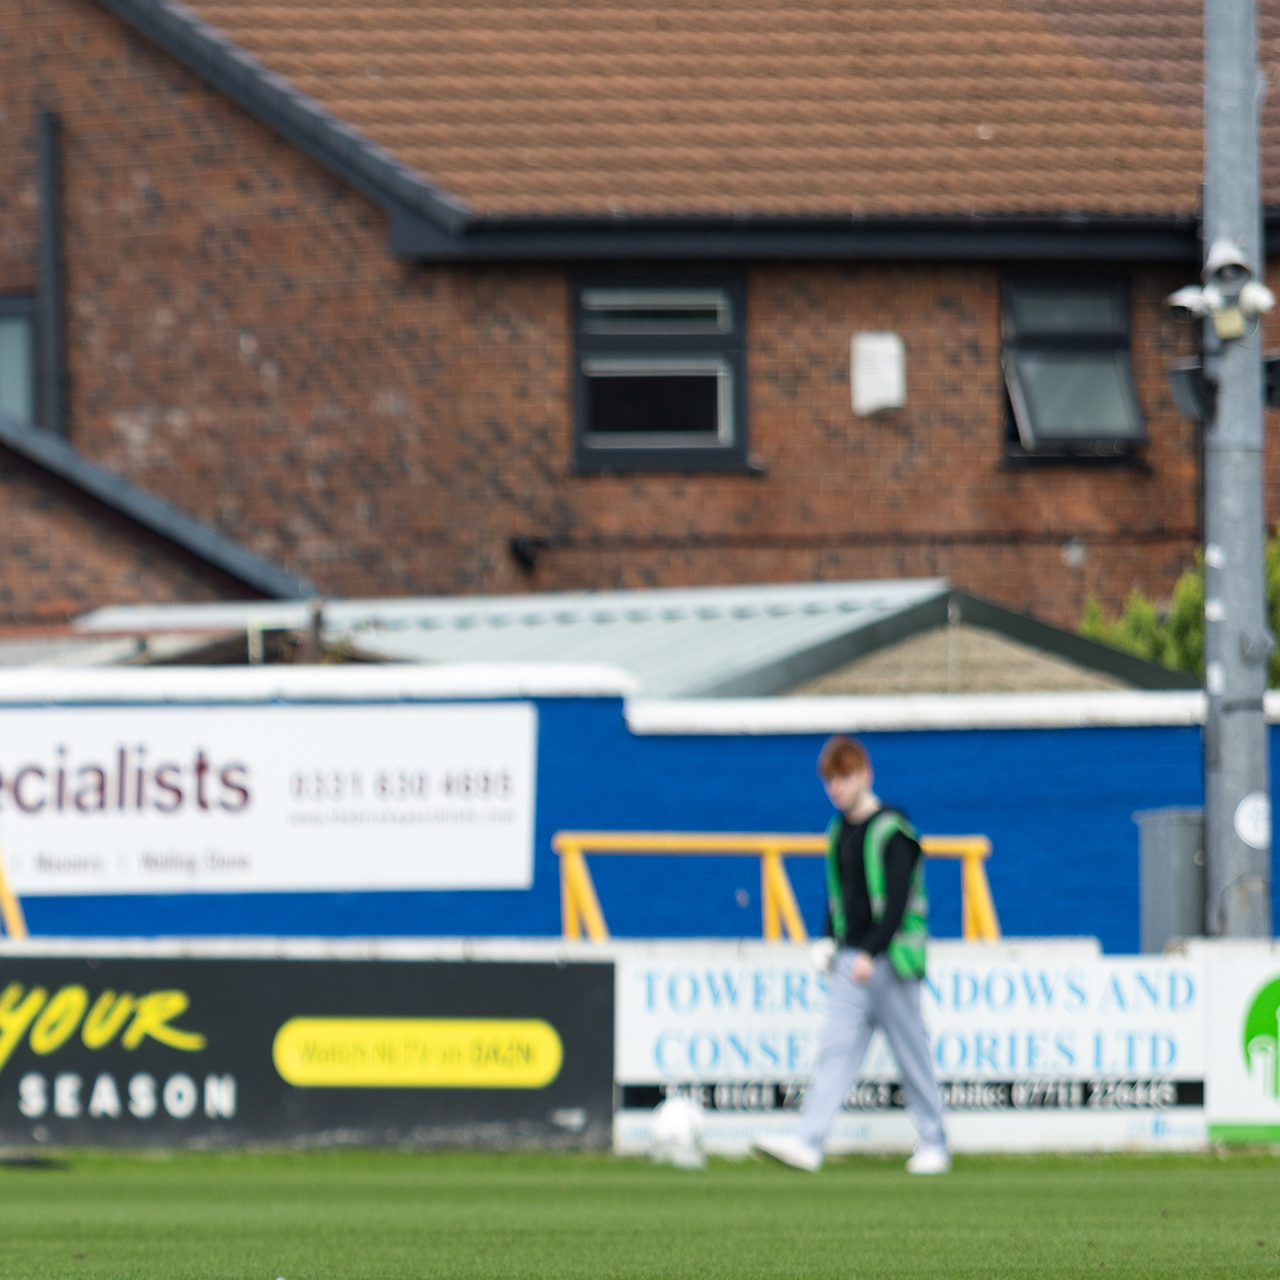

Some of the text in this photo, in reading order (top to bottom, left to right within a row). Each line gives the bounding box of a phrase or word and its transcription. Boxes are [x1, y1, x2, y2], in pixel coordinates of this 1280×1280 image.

[1098, 967, 1196, 1013] AND
[1091, 1027, 1179, 1075] LTD
[17, 1070, 237, 1119] SEASON
